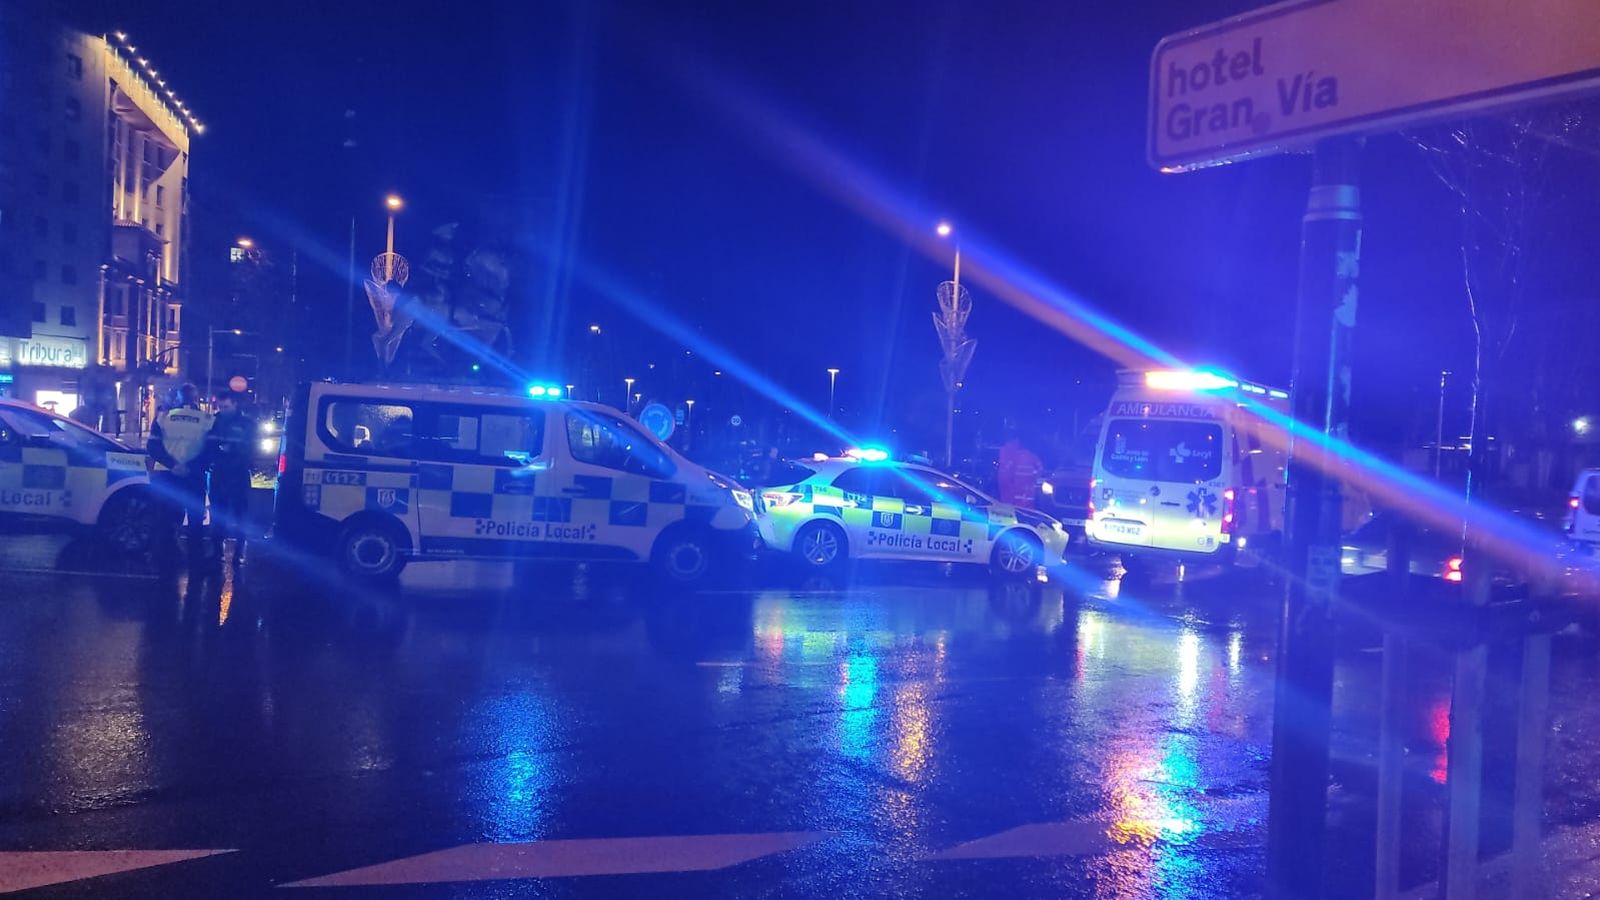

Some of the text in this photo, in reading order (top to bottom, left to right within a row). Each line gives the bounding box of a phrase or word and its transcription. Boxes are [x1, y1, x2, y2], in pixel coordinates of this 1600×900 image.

[1168, 37, 1265, 98] hotel
[1166, 70, 1339, 140] Gran Vía
[1117, 403, 1216, 417] AMBULANCIA
[1, 489, 51, 507] Local
[486, 520, 586, 540] Policía Local
[878, 533, 960, 552] Policía Local
